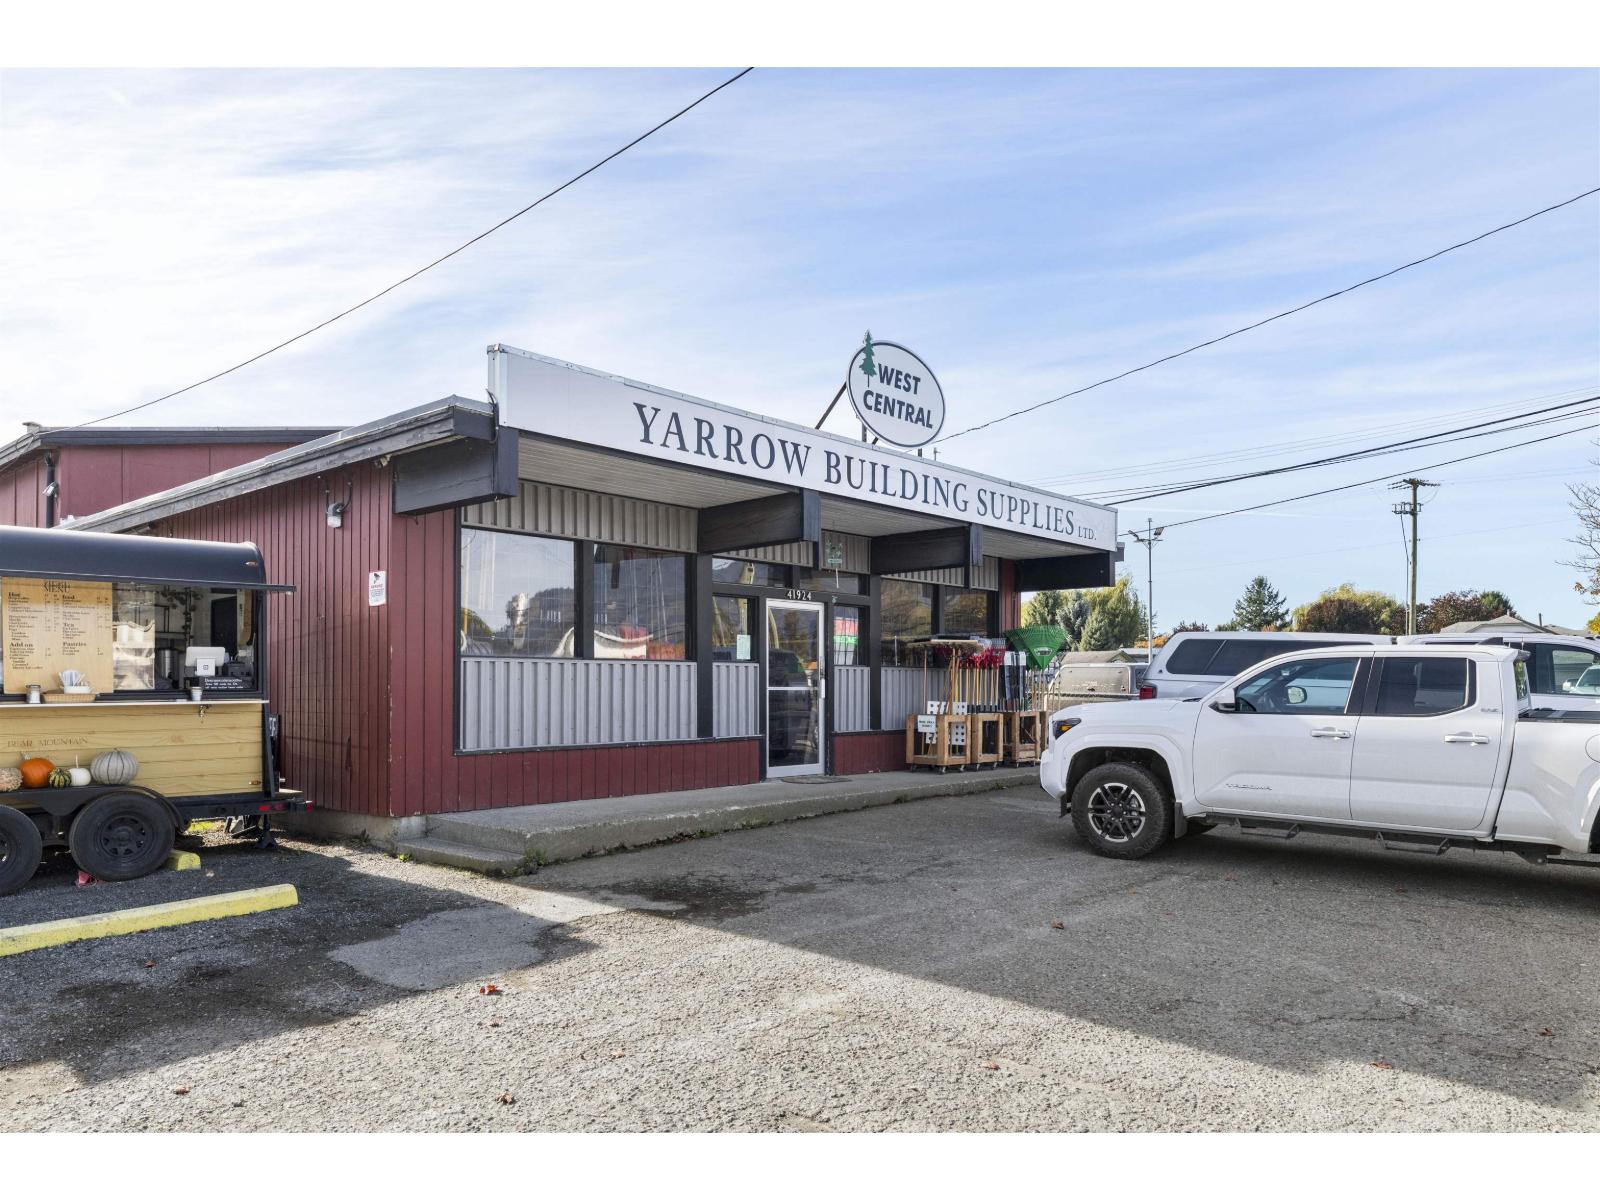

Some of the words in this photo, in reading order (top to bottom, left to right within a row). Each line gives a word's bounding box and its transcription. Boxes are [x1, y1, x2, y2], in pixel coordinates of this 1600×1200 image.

[878, 363, 921, 395] WEST
[863, 389, 933, 429] CENTRAL
[633, 402, 812, 477] YARROW
[824, 450, 968, 512] BUILDING
[977, 488, 1074, 536] SUPPLIES
[1078, 526, 1097, 541] LTD.
[787, 590, 811, 601] 41924
[39, 737, 88, 746] MOUNTAIN
